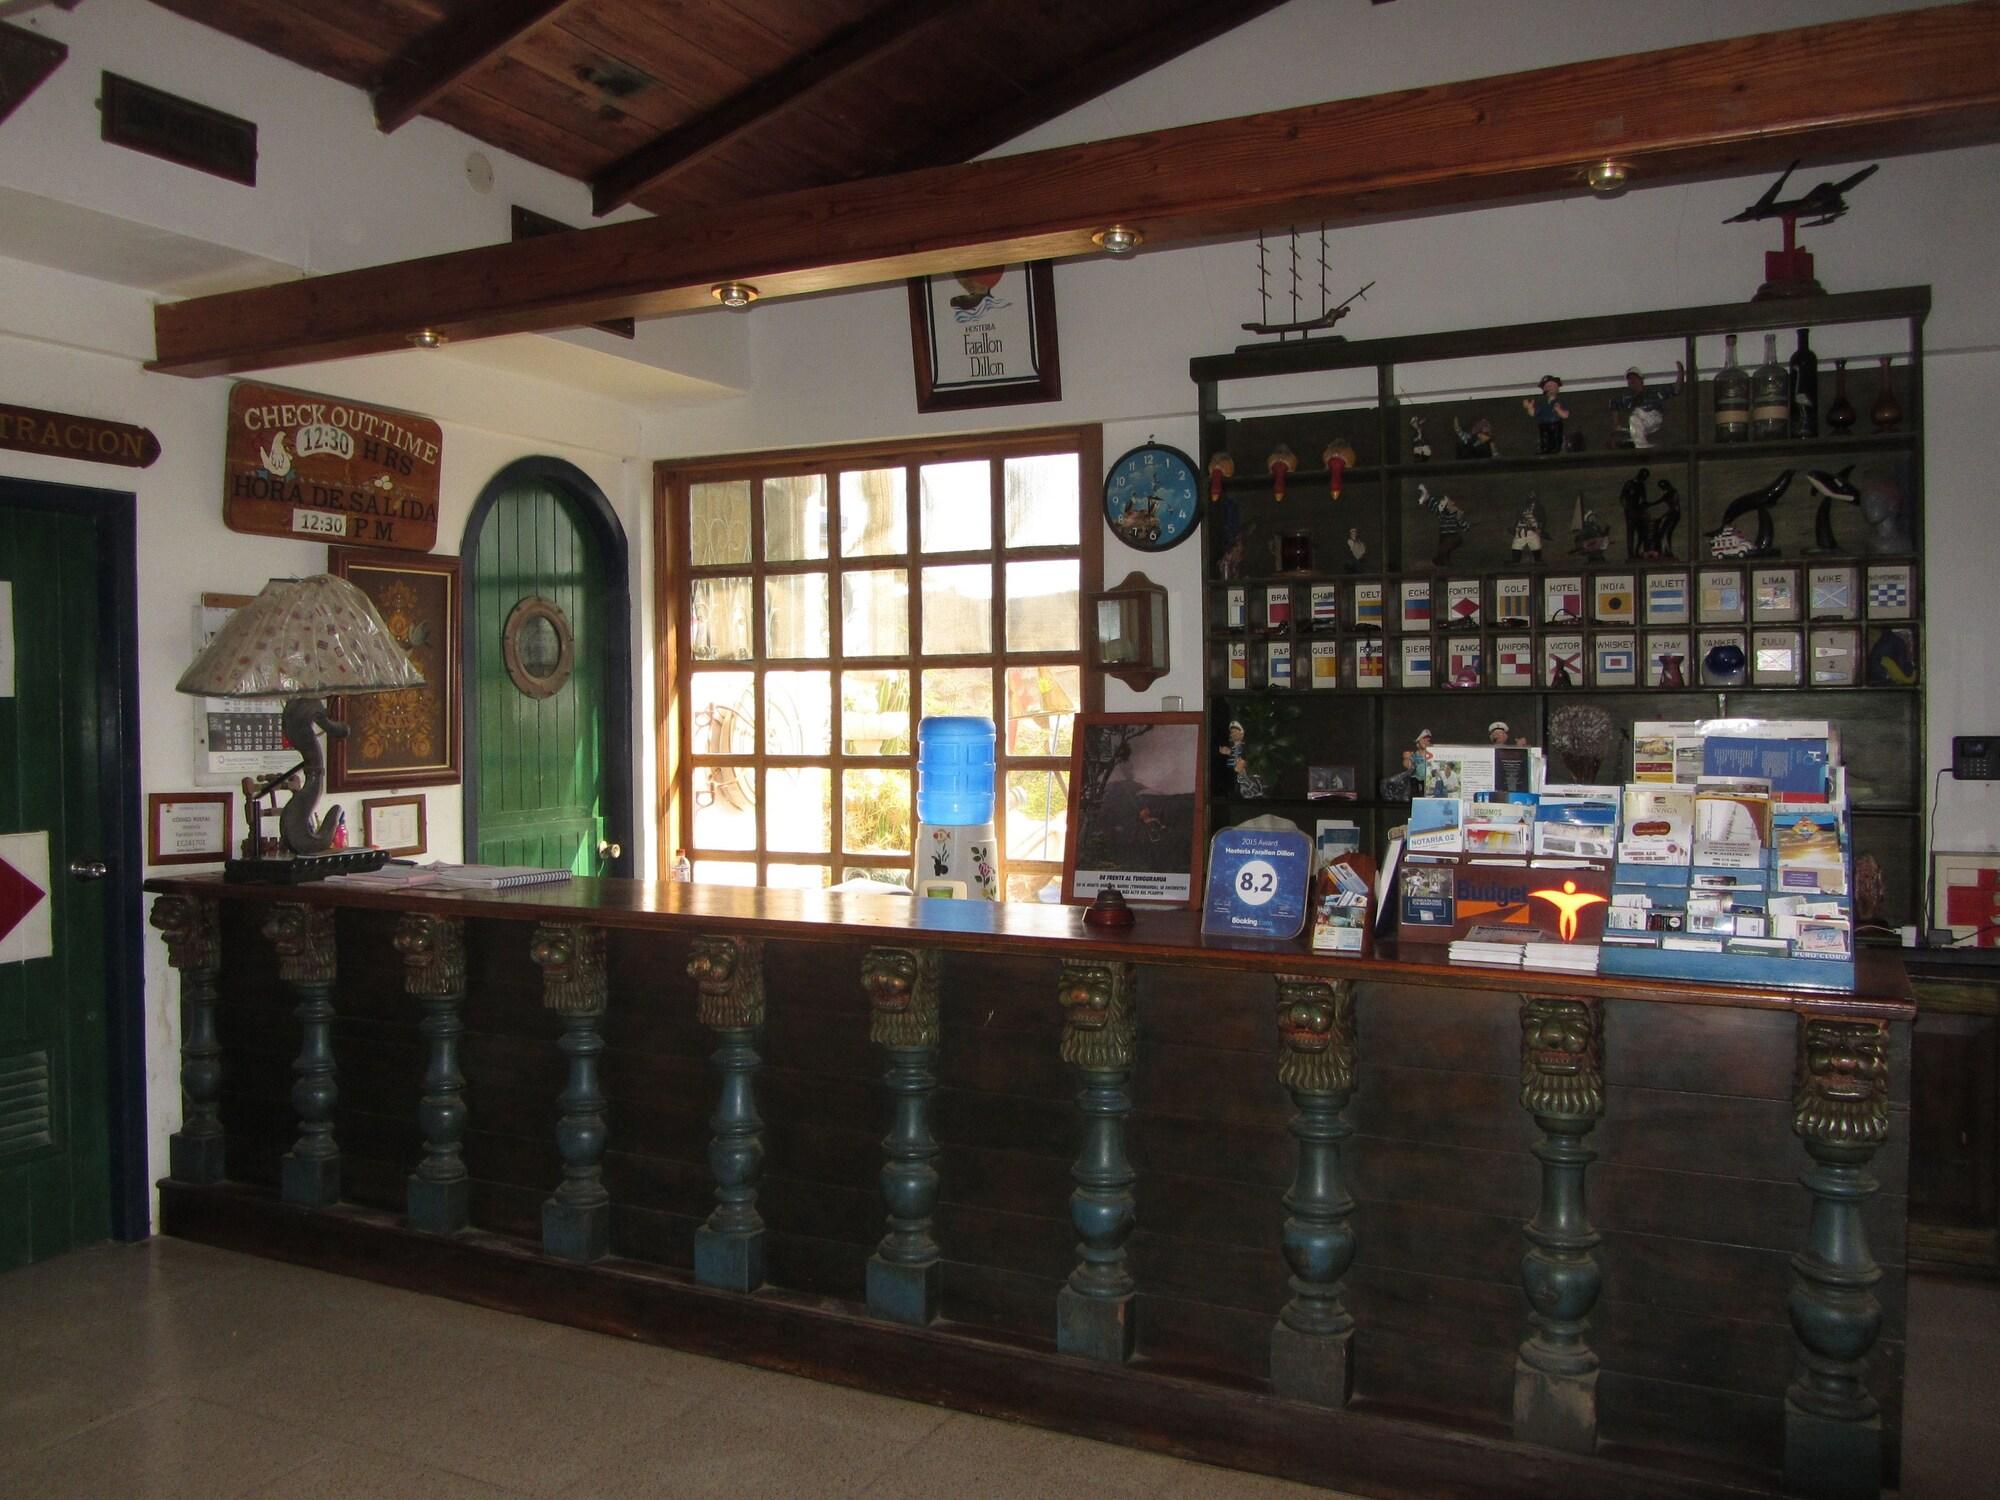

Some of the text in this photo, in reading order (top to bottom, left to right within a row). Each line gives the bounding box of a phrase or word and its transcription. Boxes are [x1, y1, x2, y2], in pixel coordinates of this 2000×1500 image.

[964, 332, 1002, 355] Farallon
[970, 356, 1004, 377] Dillon
[244, 403, 326, 430] CHECK
[380, 421, 438, 465] TIME
[303, 426, 349, 455] 12:30
[1143, 454, 1154, 465] 12
[1178, 470, 1186, 481] 2
[1116, 476, 1126, 489] 10
[232, 473, 438, 522] HORA DE SALIDA
[1184, 489, 1192, 499] 3
[1112, 496, 1119, 504] 9
[1178, 510, 1187, 519] 4
[301, 514, 343, 533] 12:30
[1132, 527, 1138, 536] 7
[1167, 523, 1176, 534] 5
[1149, 530, 1157, 541] 6
[1650, 579, 1685, 588] JULIETT
[1711, 577, 1733, 586] KILO
[1762, 576, 1786, 585] LIMA
[1817, 575, 1842, 584] MIKE
[1504, 585, 1528, 593] GOLF
[1549, 583, 1579, 592] HOTEL
[1600, 582, 1625, 590] INDIA
[1271, 593, 1289, 602] BRA
[1360, 591, 1383, 599] DELT
[1550, 641, 1580, 650] VICTOR
[1597, 640, 1635, 649] WHISKEY
[1651, 641, 1681, 649] X-RAY
[1702, 638, 1738, 647] YANKEE
[1761, 637, 1786, 647] ZULU
[1312, 646, 1334, 655] QUEB
[1359, 645, 1383, 654] RME
[1405, 645, 1430, 654] SIERR
[1241, 838, 1257, 846] 2015
[1240, 872, 1273, 893] 8,2
[1456, 879, 1529, 908] Budget
